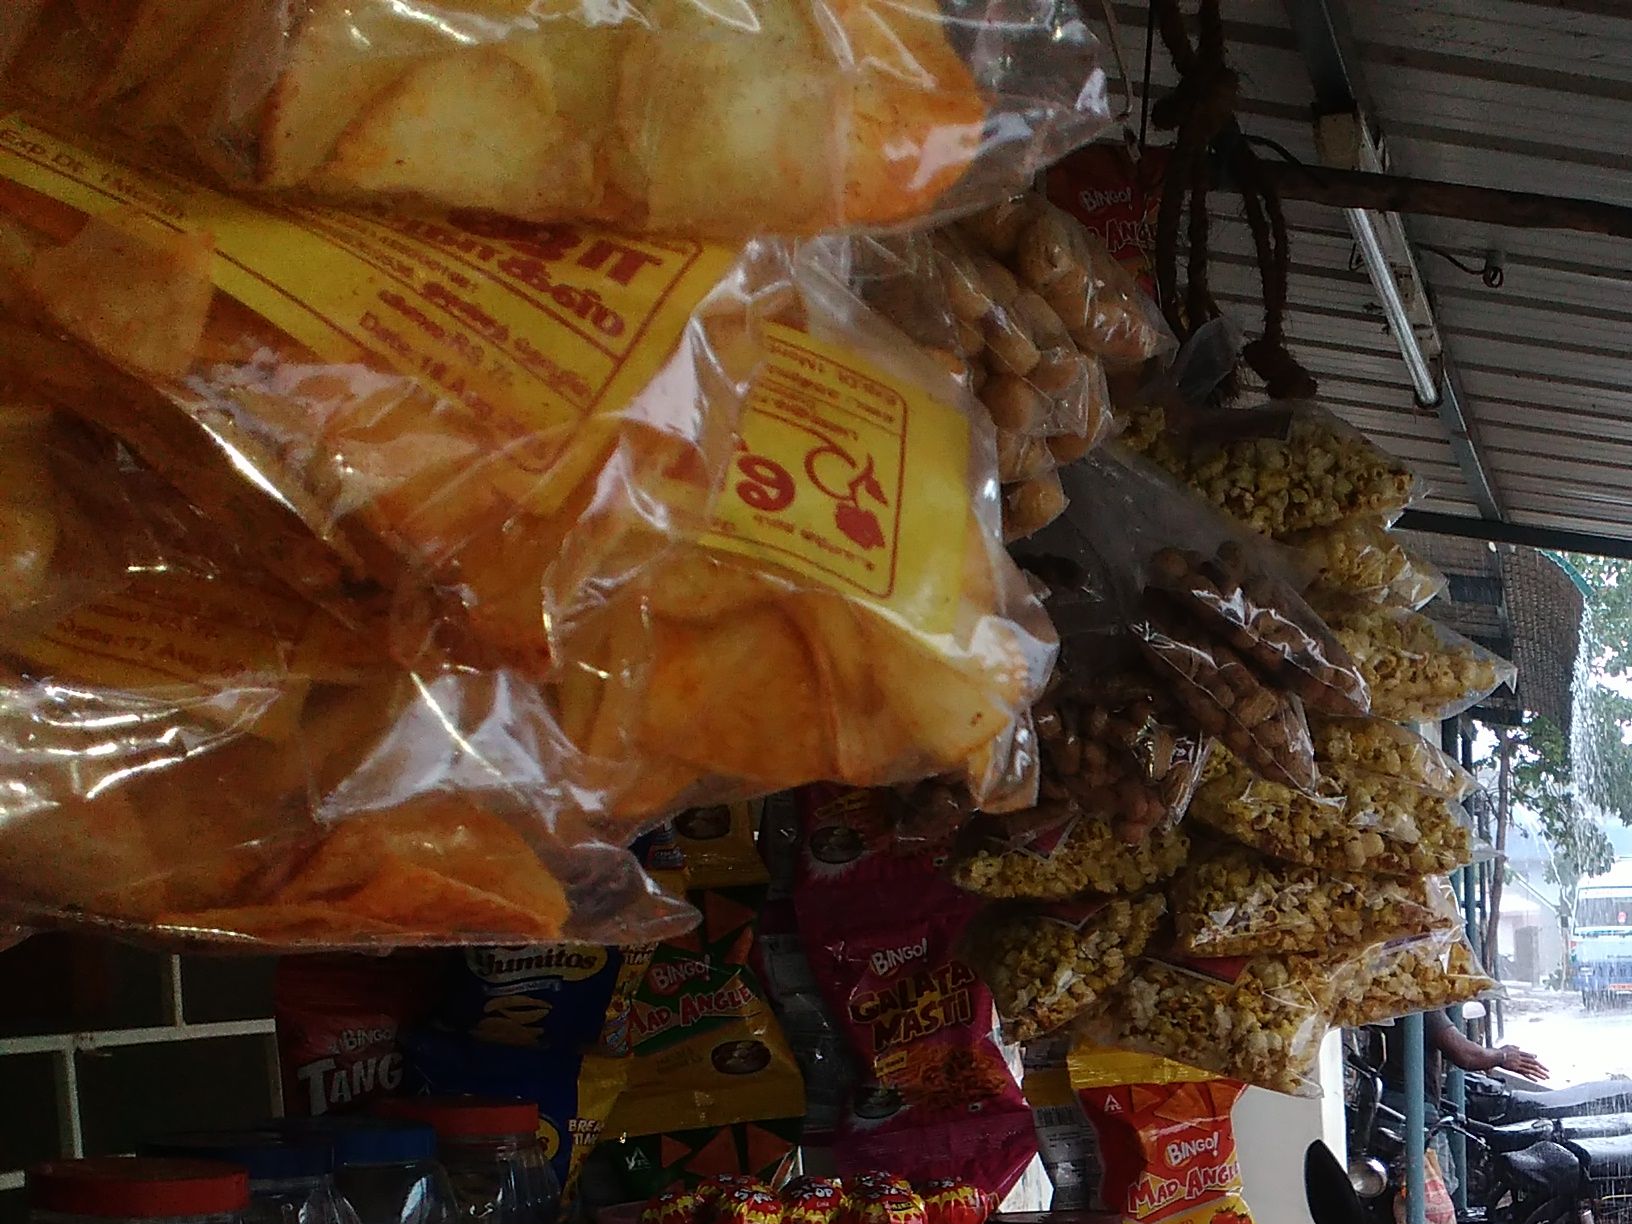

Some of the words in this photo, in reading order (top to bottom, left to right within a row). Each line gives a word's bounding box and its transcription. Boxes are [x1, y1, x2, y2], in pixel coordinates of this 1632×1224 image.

[1080, 186, 1132, 212] BINGO!
[653, 952, 713, 992] BINGO!
[871, 938, 928, 976] BINGO!
[679, 983, 755, 1028] ANGLE
[850, 961, 978, 1024] GALATA
[872, 988, 974, 1053] MASTI
[297, 1054, 404, 1116] TANG
[1166, 1132, 1220, 1166] BINGO!
[1129, 1178, 1180, 1214] MAD
